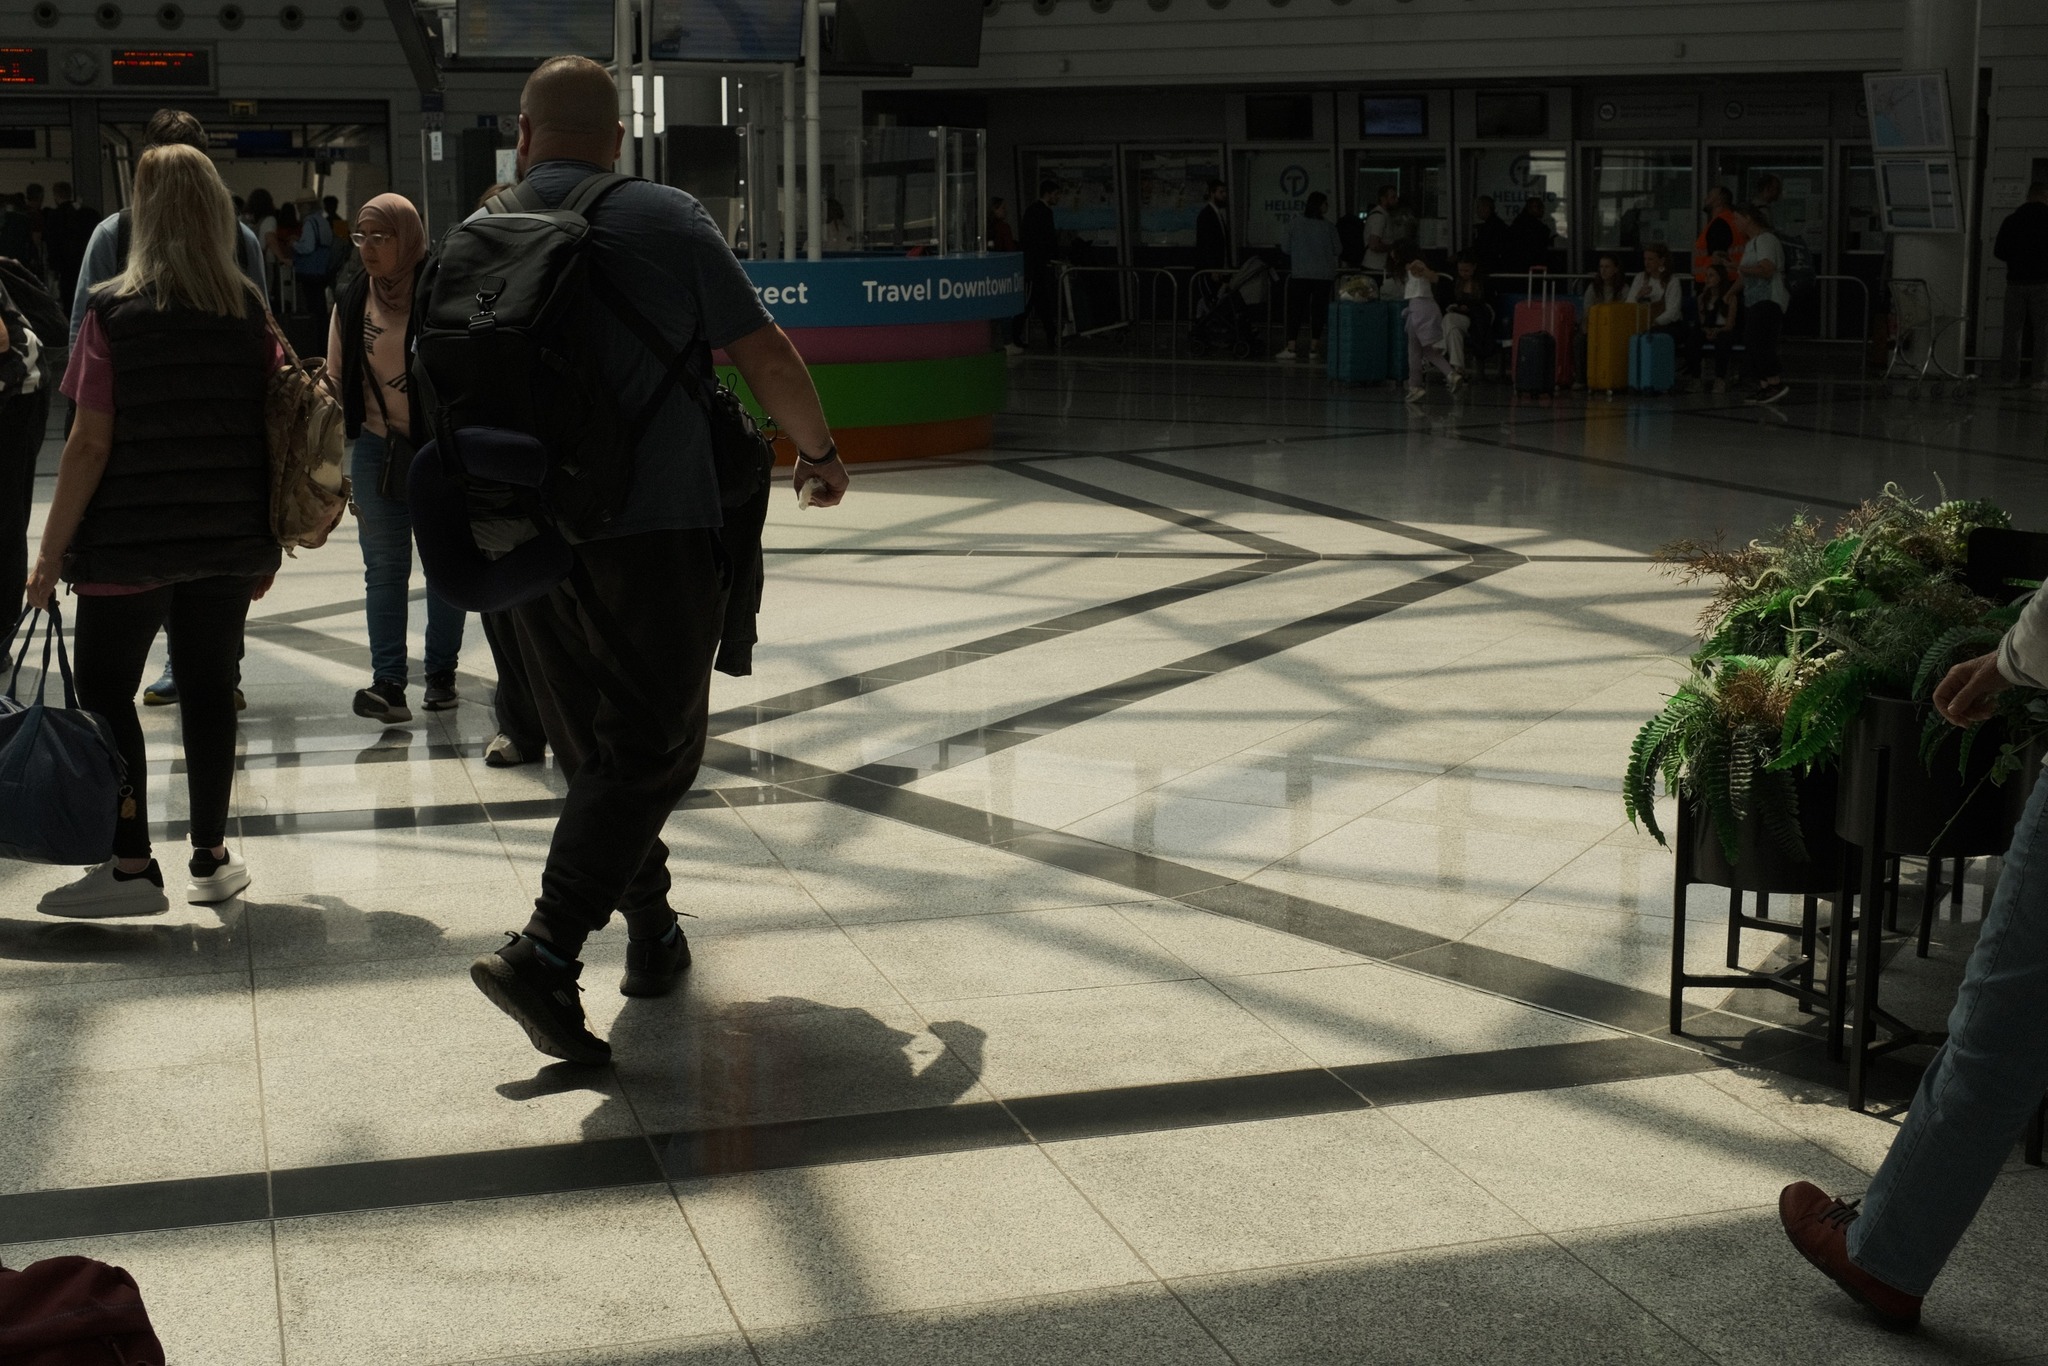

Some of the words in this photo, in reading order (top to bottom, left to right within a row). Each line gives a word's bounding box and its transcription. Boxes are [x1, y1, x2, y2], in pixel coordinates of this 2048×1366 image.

[1493, 190, 1555, 203] HELLEIC
[861, 278, 931, 303] Travel
[938, 275, 1012, 300] Downtown
